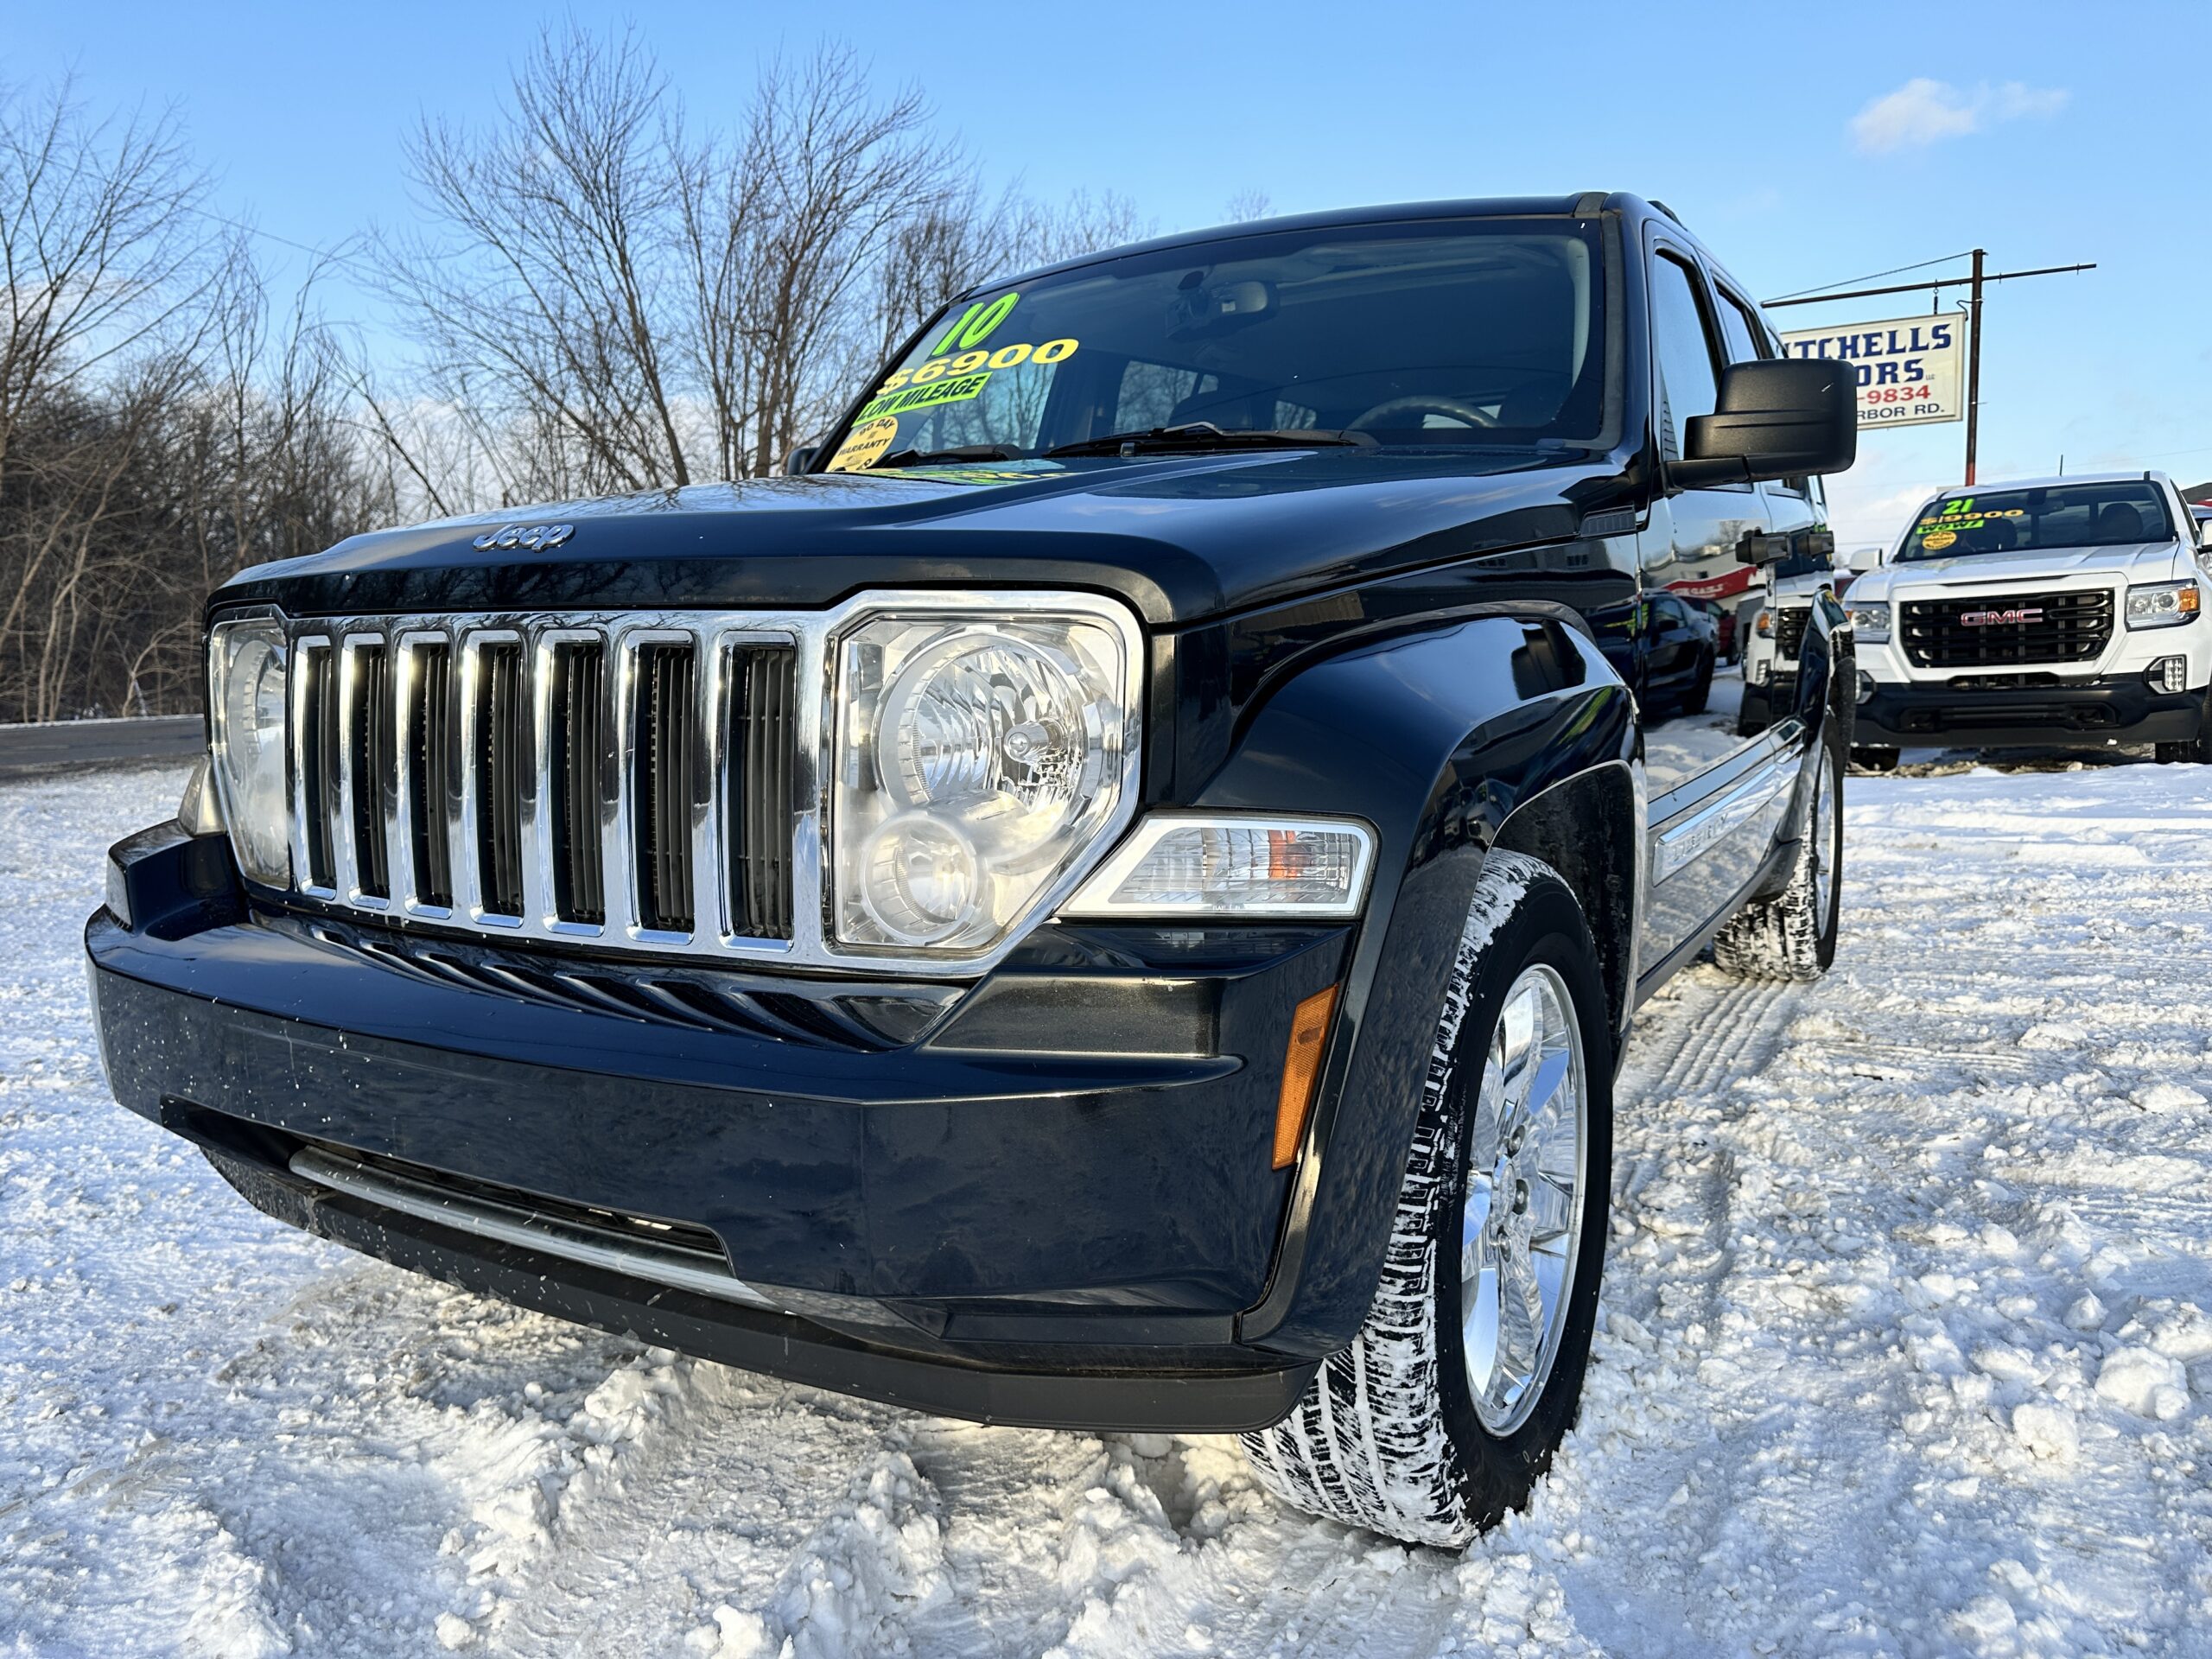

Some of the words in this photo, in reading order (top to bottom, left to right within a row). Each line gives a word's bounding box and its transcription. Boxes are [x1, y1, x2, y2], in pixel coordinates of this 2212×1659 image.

[930, 292, 1020, 358] 10
[876, 339, 1079, 396] $6900
[856, 395, 902, 422] LOW
[893, 375, 987, 410] MILEAGE
[1914, 403, 1945, 415] RD.
[875, 418, 895, 430] DAY
[837, 436, 892, 457] WARRANTY
[1942, 498, 1974, 515] 21
[473, 524, 576, 553] Jeep
[1961, 608, 2043, 626] GMC
